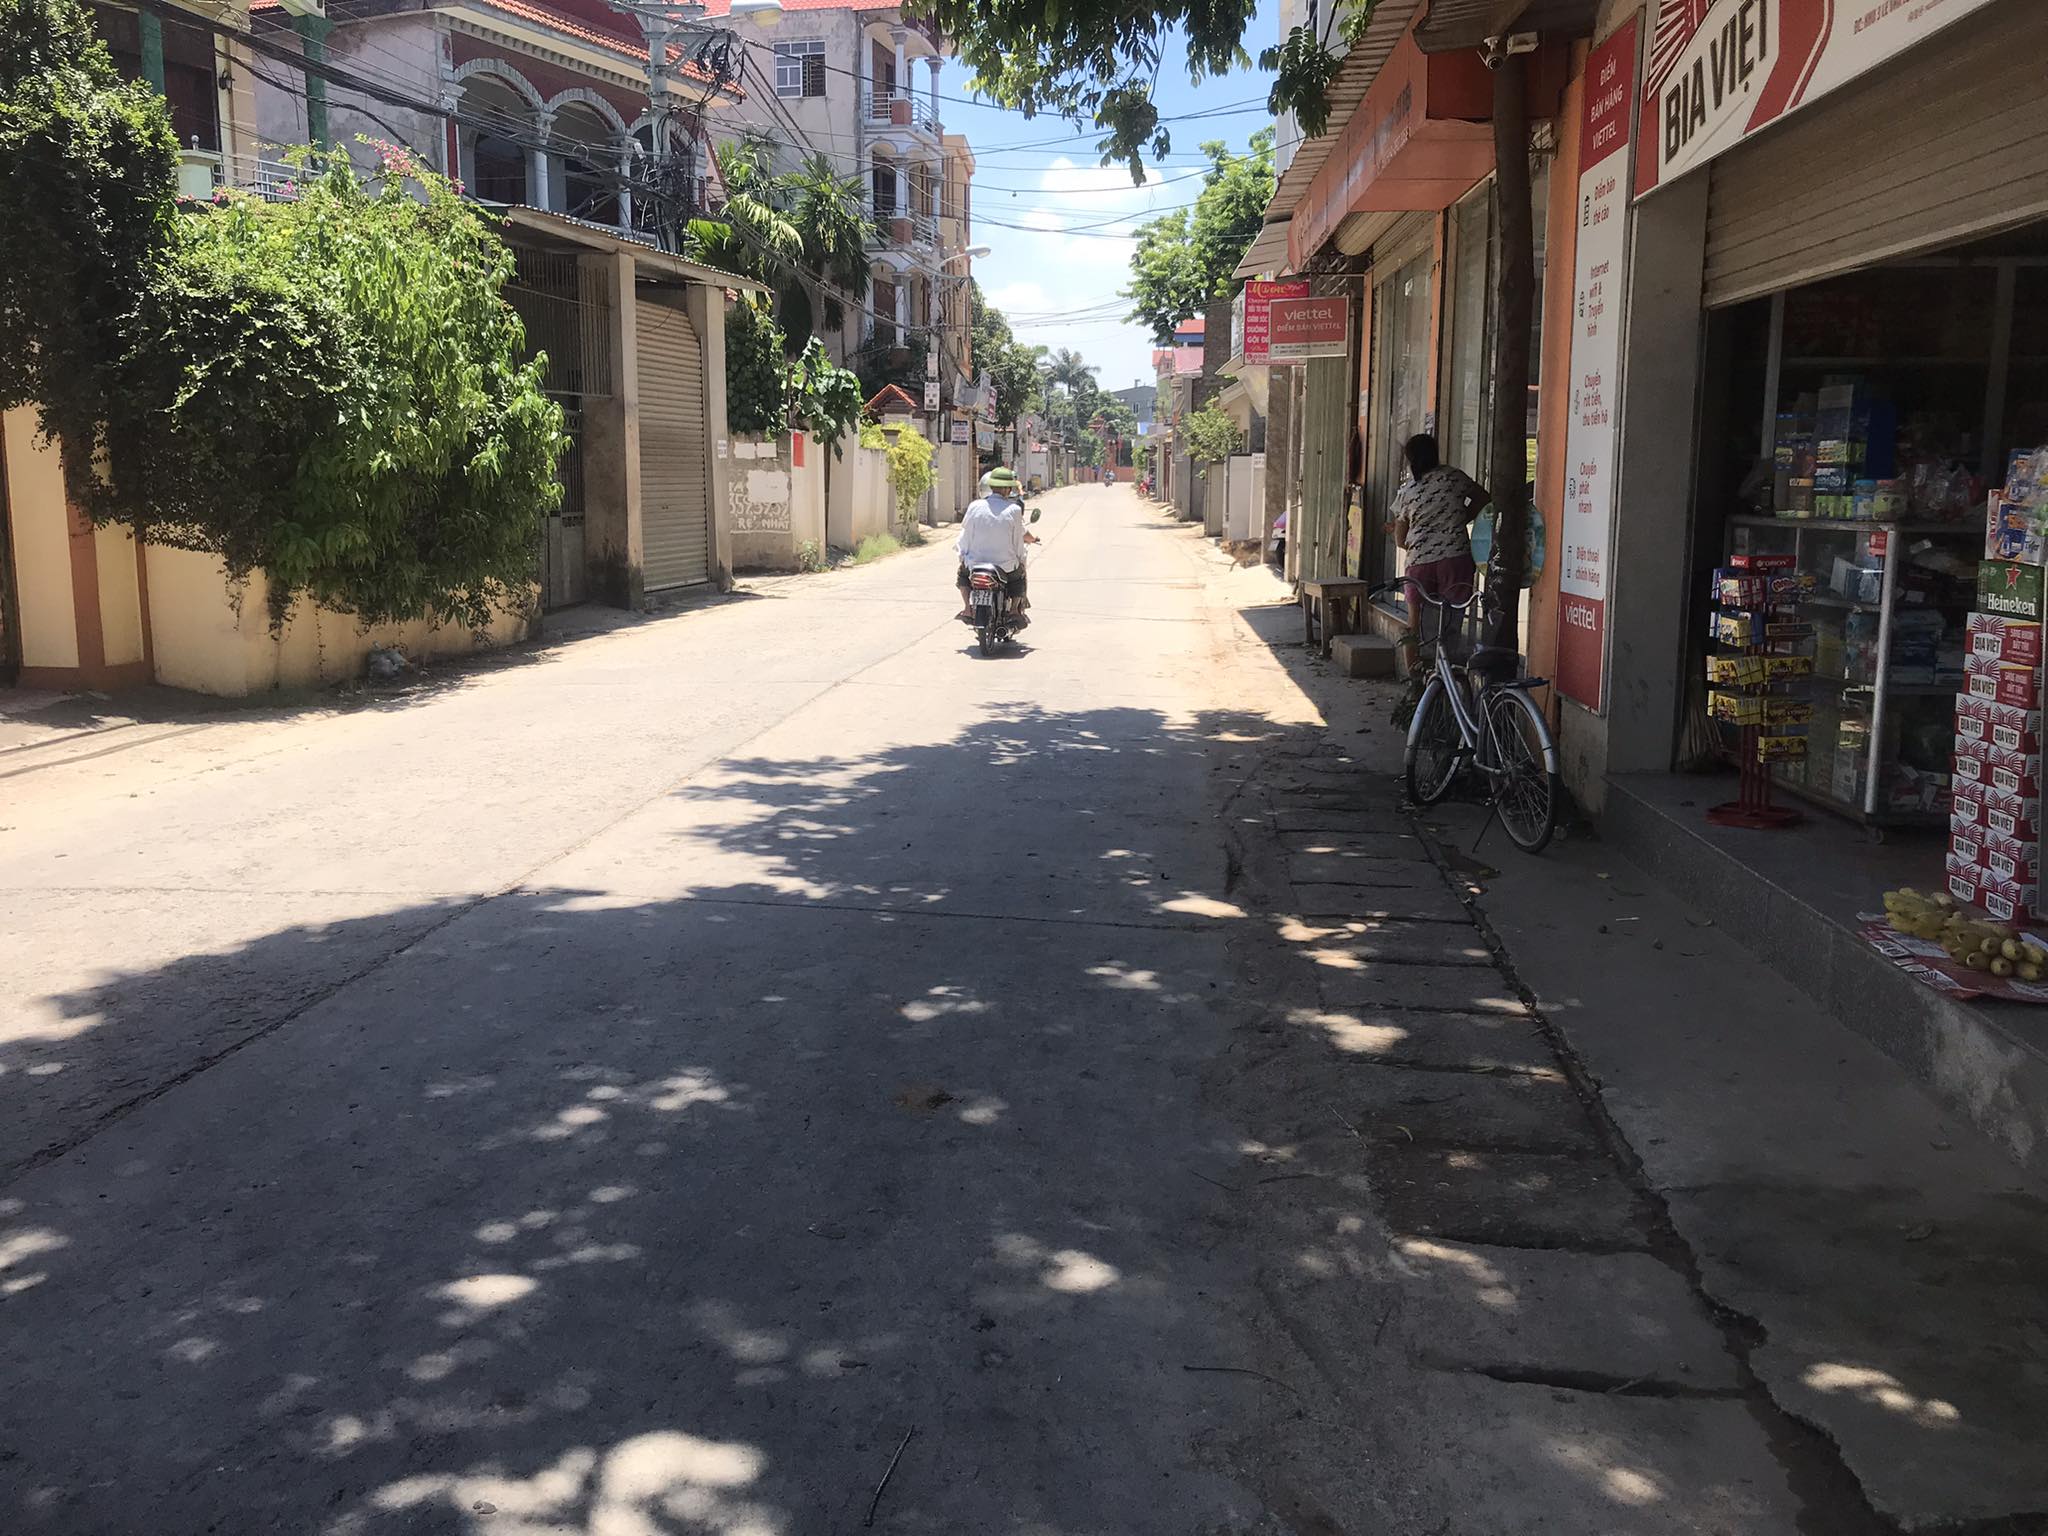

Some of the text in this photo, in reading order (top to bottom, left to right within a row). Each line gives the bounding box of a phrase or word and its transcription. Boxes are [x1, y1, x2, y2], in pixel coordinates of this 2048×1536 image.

[1591, 83, 1623, 123] BÁN HÀNG
[1665, 56, 1705, 164] BIA
[1592, 120, 1617, 150] VIETTEL
[1590, 260, 1610, 280] Internet
[1284, 307, 1333, 321] viettel
[1565, 601, 1596, 631] viettel
[1988, 593, 2036, 616] Heineken
